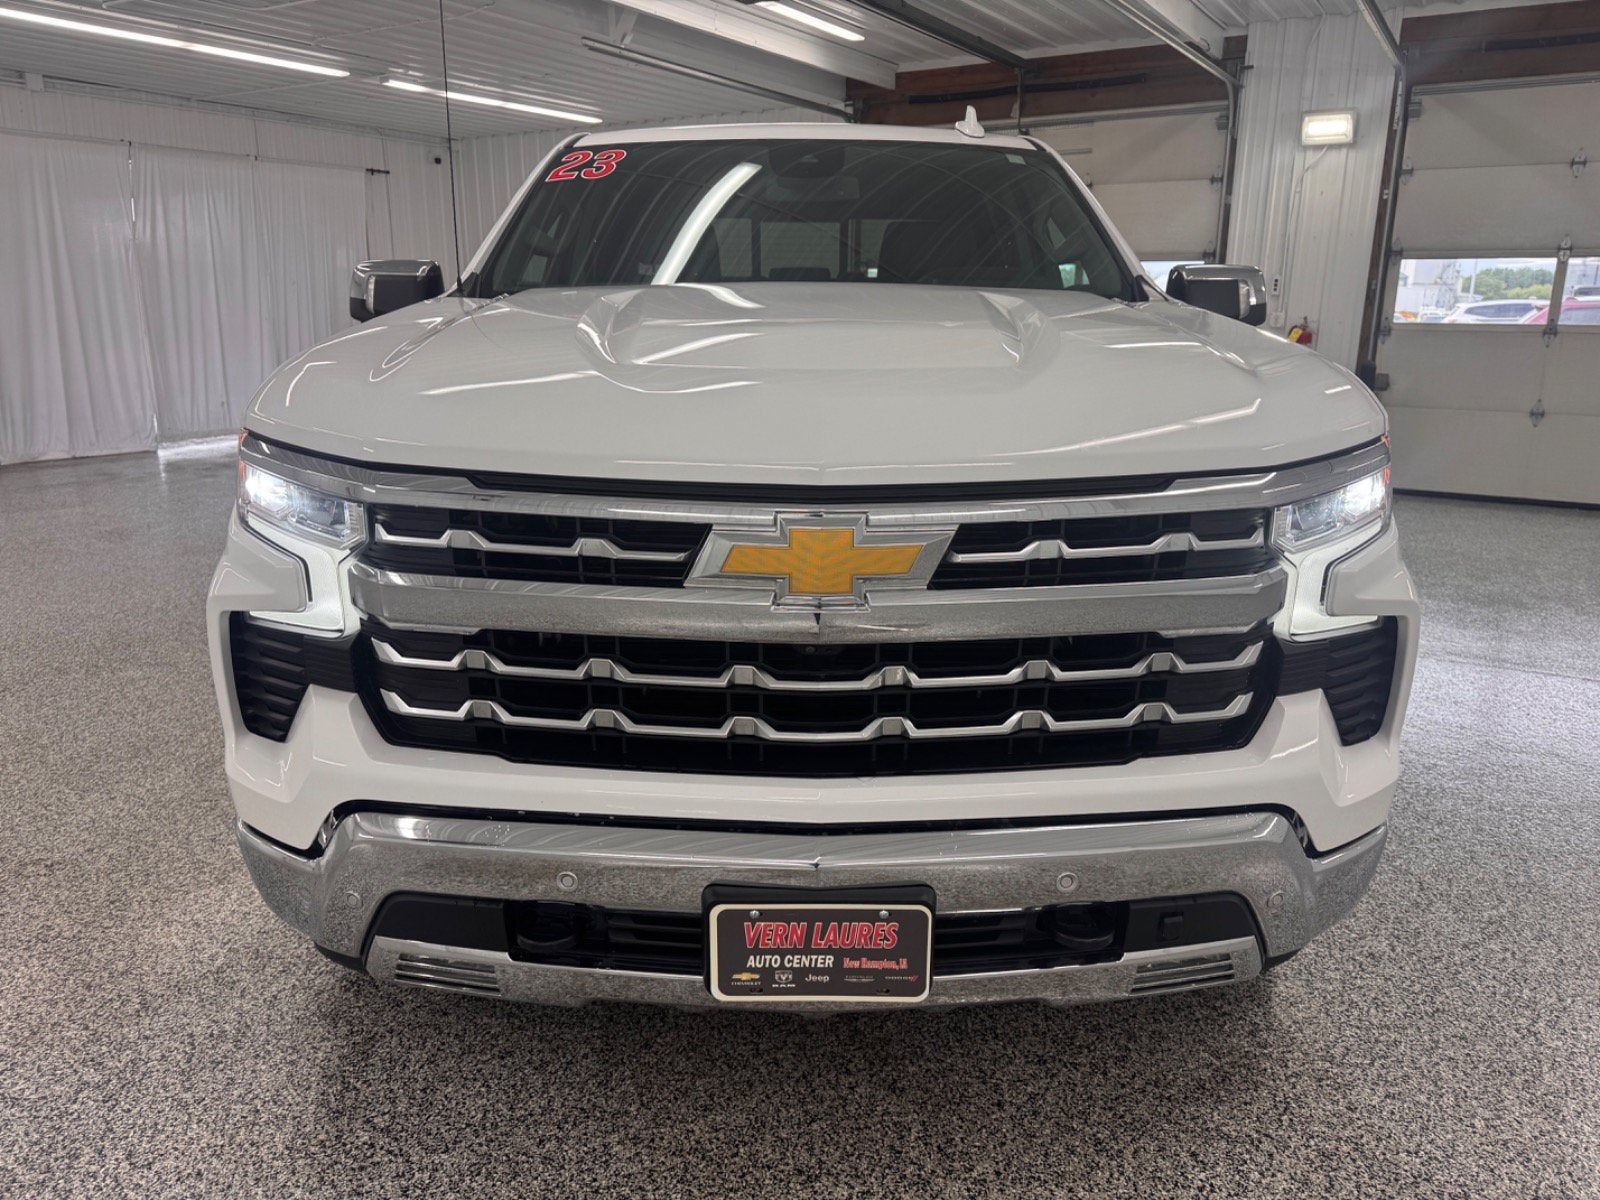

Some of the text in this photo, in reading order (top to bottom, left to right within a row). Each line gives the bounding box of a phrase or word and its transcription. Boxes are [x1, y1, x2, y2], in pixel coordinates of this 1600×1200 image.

[545, 149, 627, 182] 23
[743, 921, 899, 949] VERN LAURES
[746, 954, 834, 969] AUTO CENTER
[843, 957, 860, 969] New
[805, 972, 830, 984] Jeep
